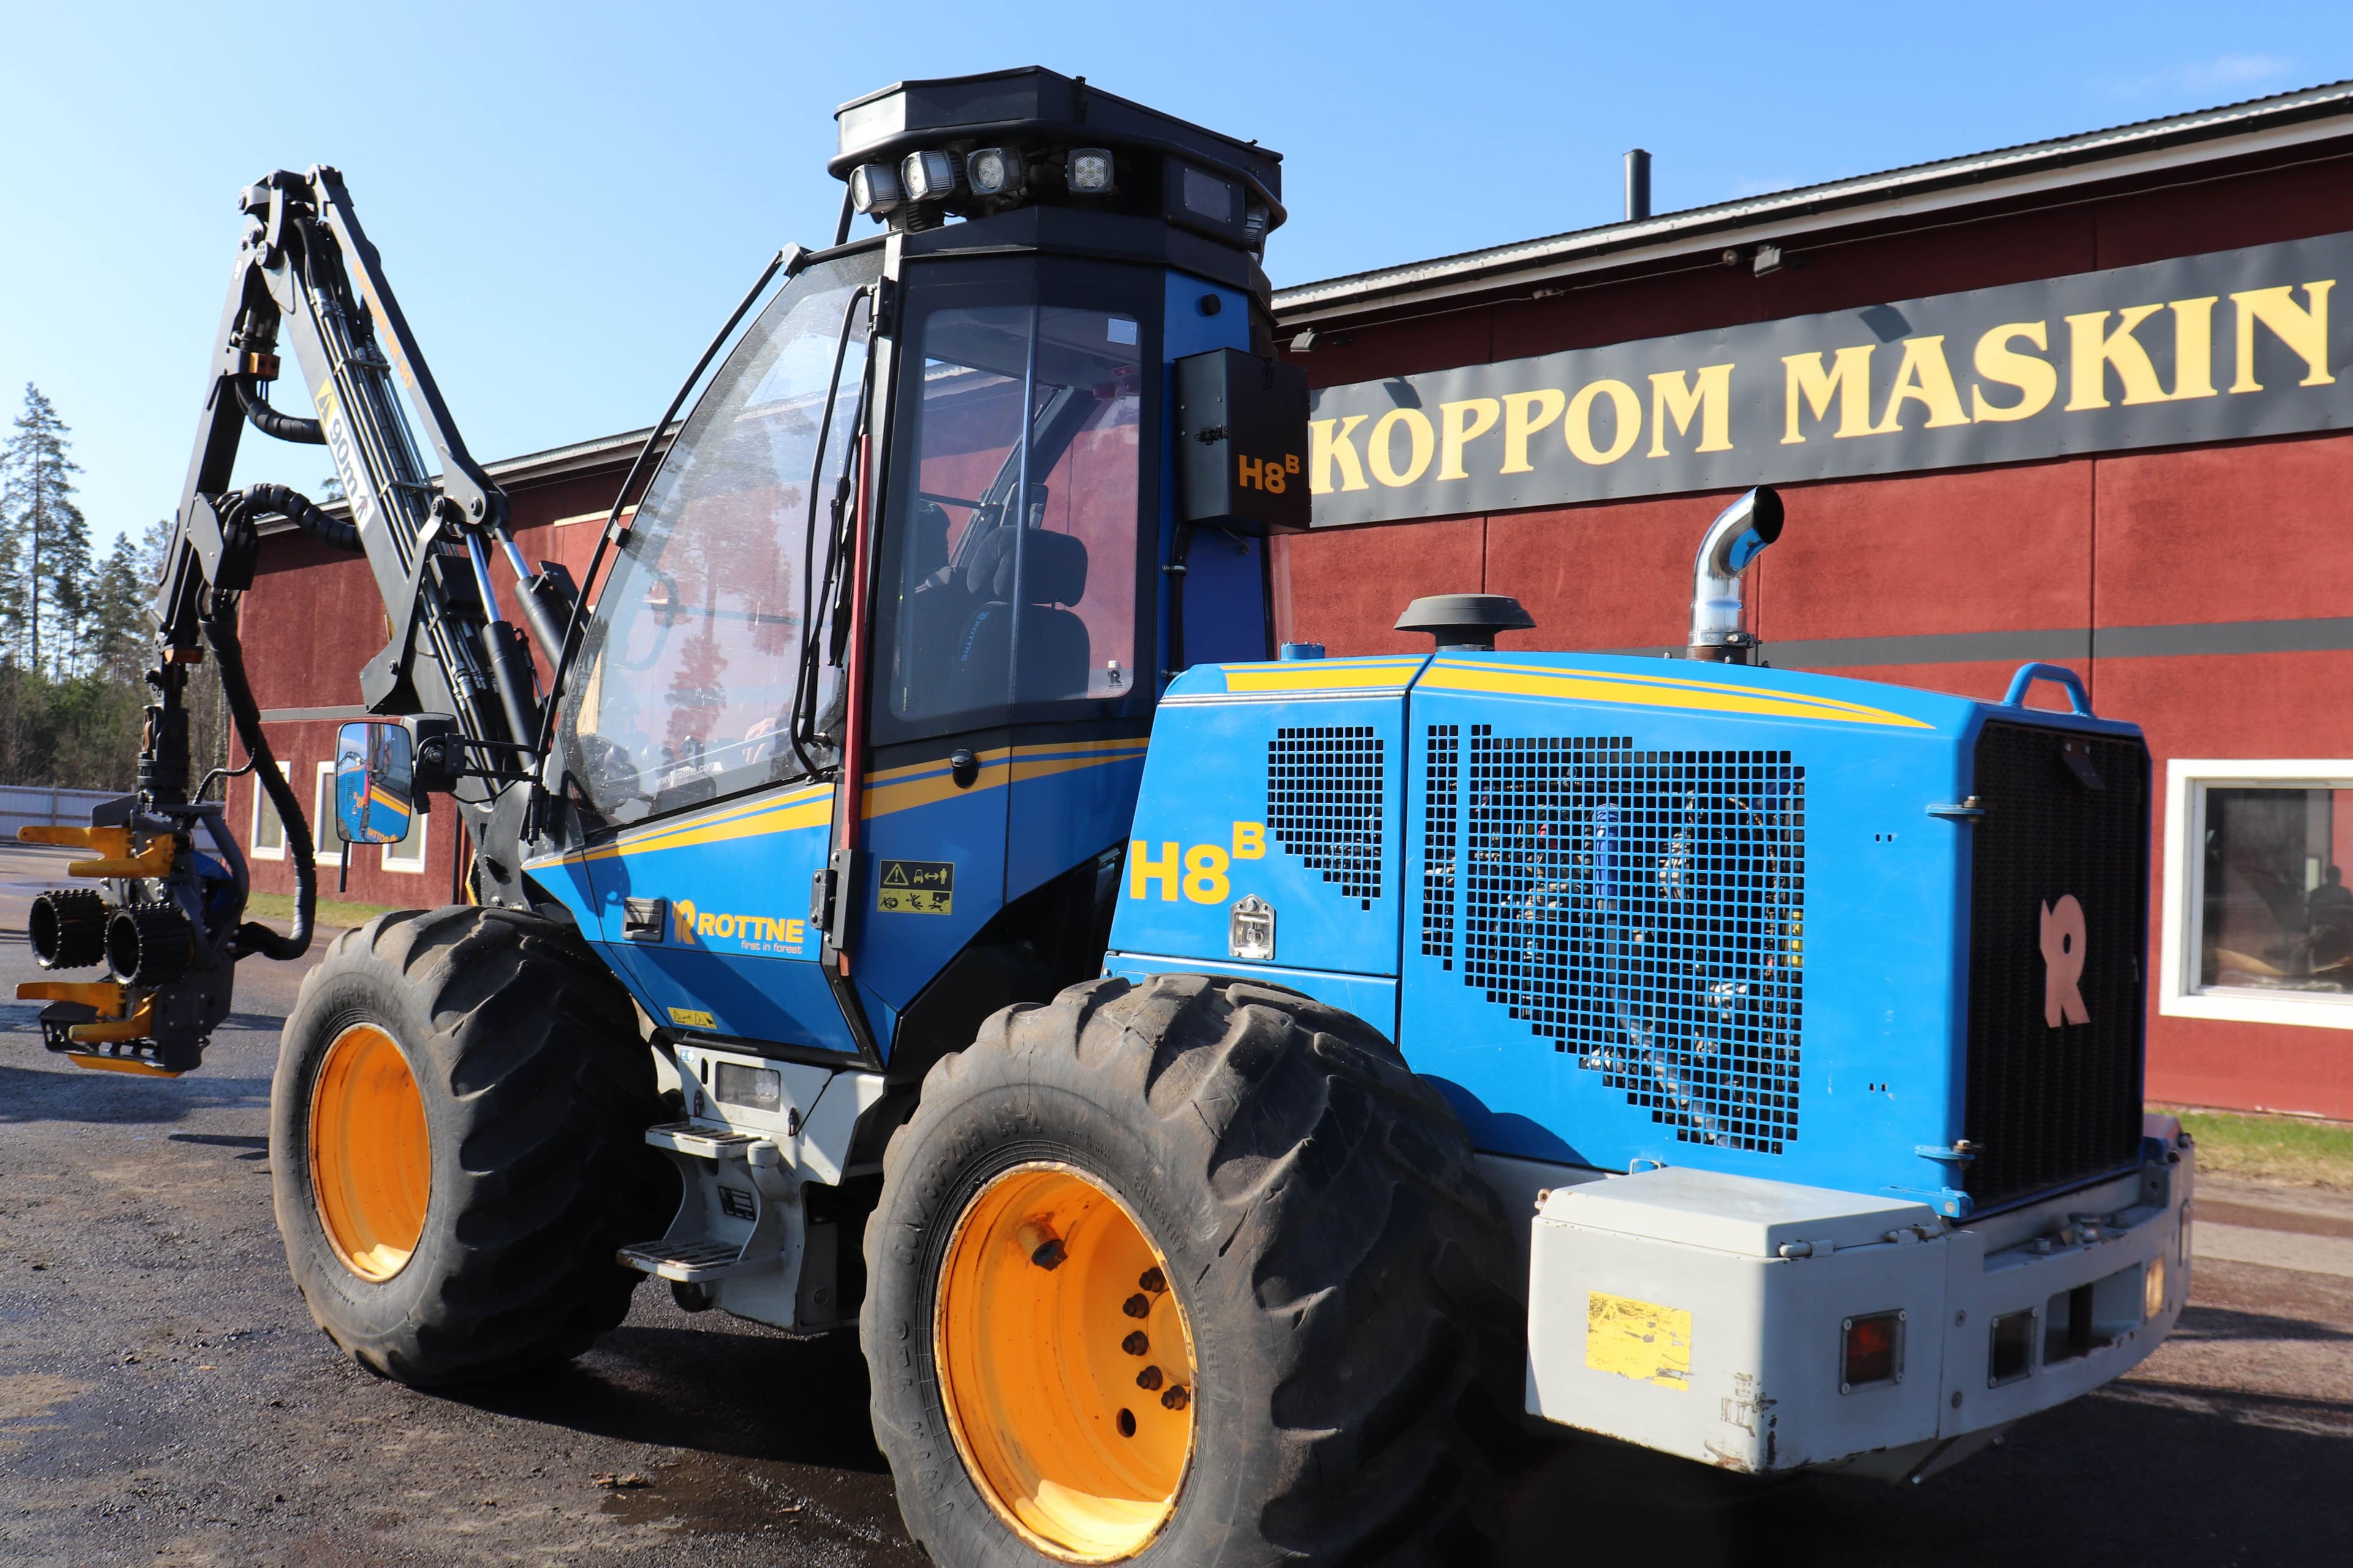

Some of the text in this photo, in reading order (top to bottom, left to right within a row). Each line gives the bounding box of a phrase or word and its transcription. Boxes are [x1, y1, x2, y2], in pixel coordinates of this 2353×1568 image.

[1309, 279, 2336, 494] KOPPOM MASKIN
[330, 420, 358, 498] 90m
[697, 912, 805, 944] ROTTNE
[741, 940, 803, 955] first in forest
